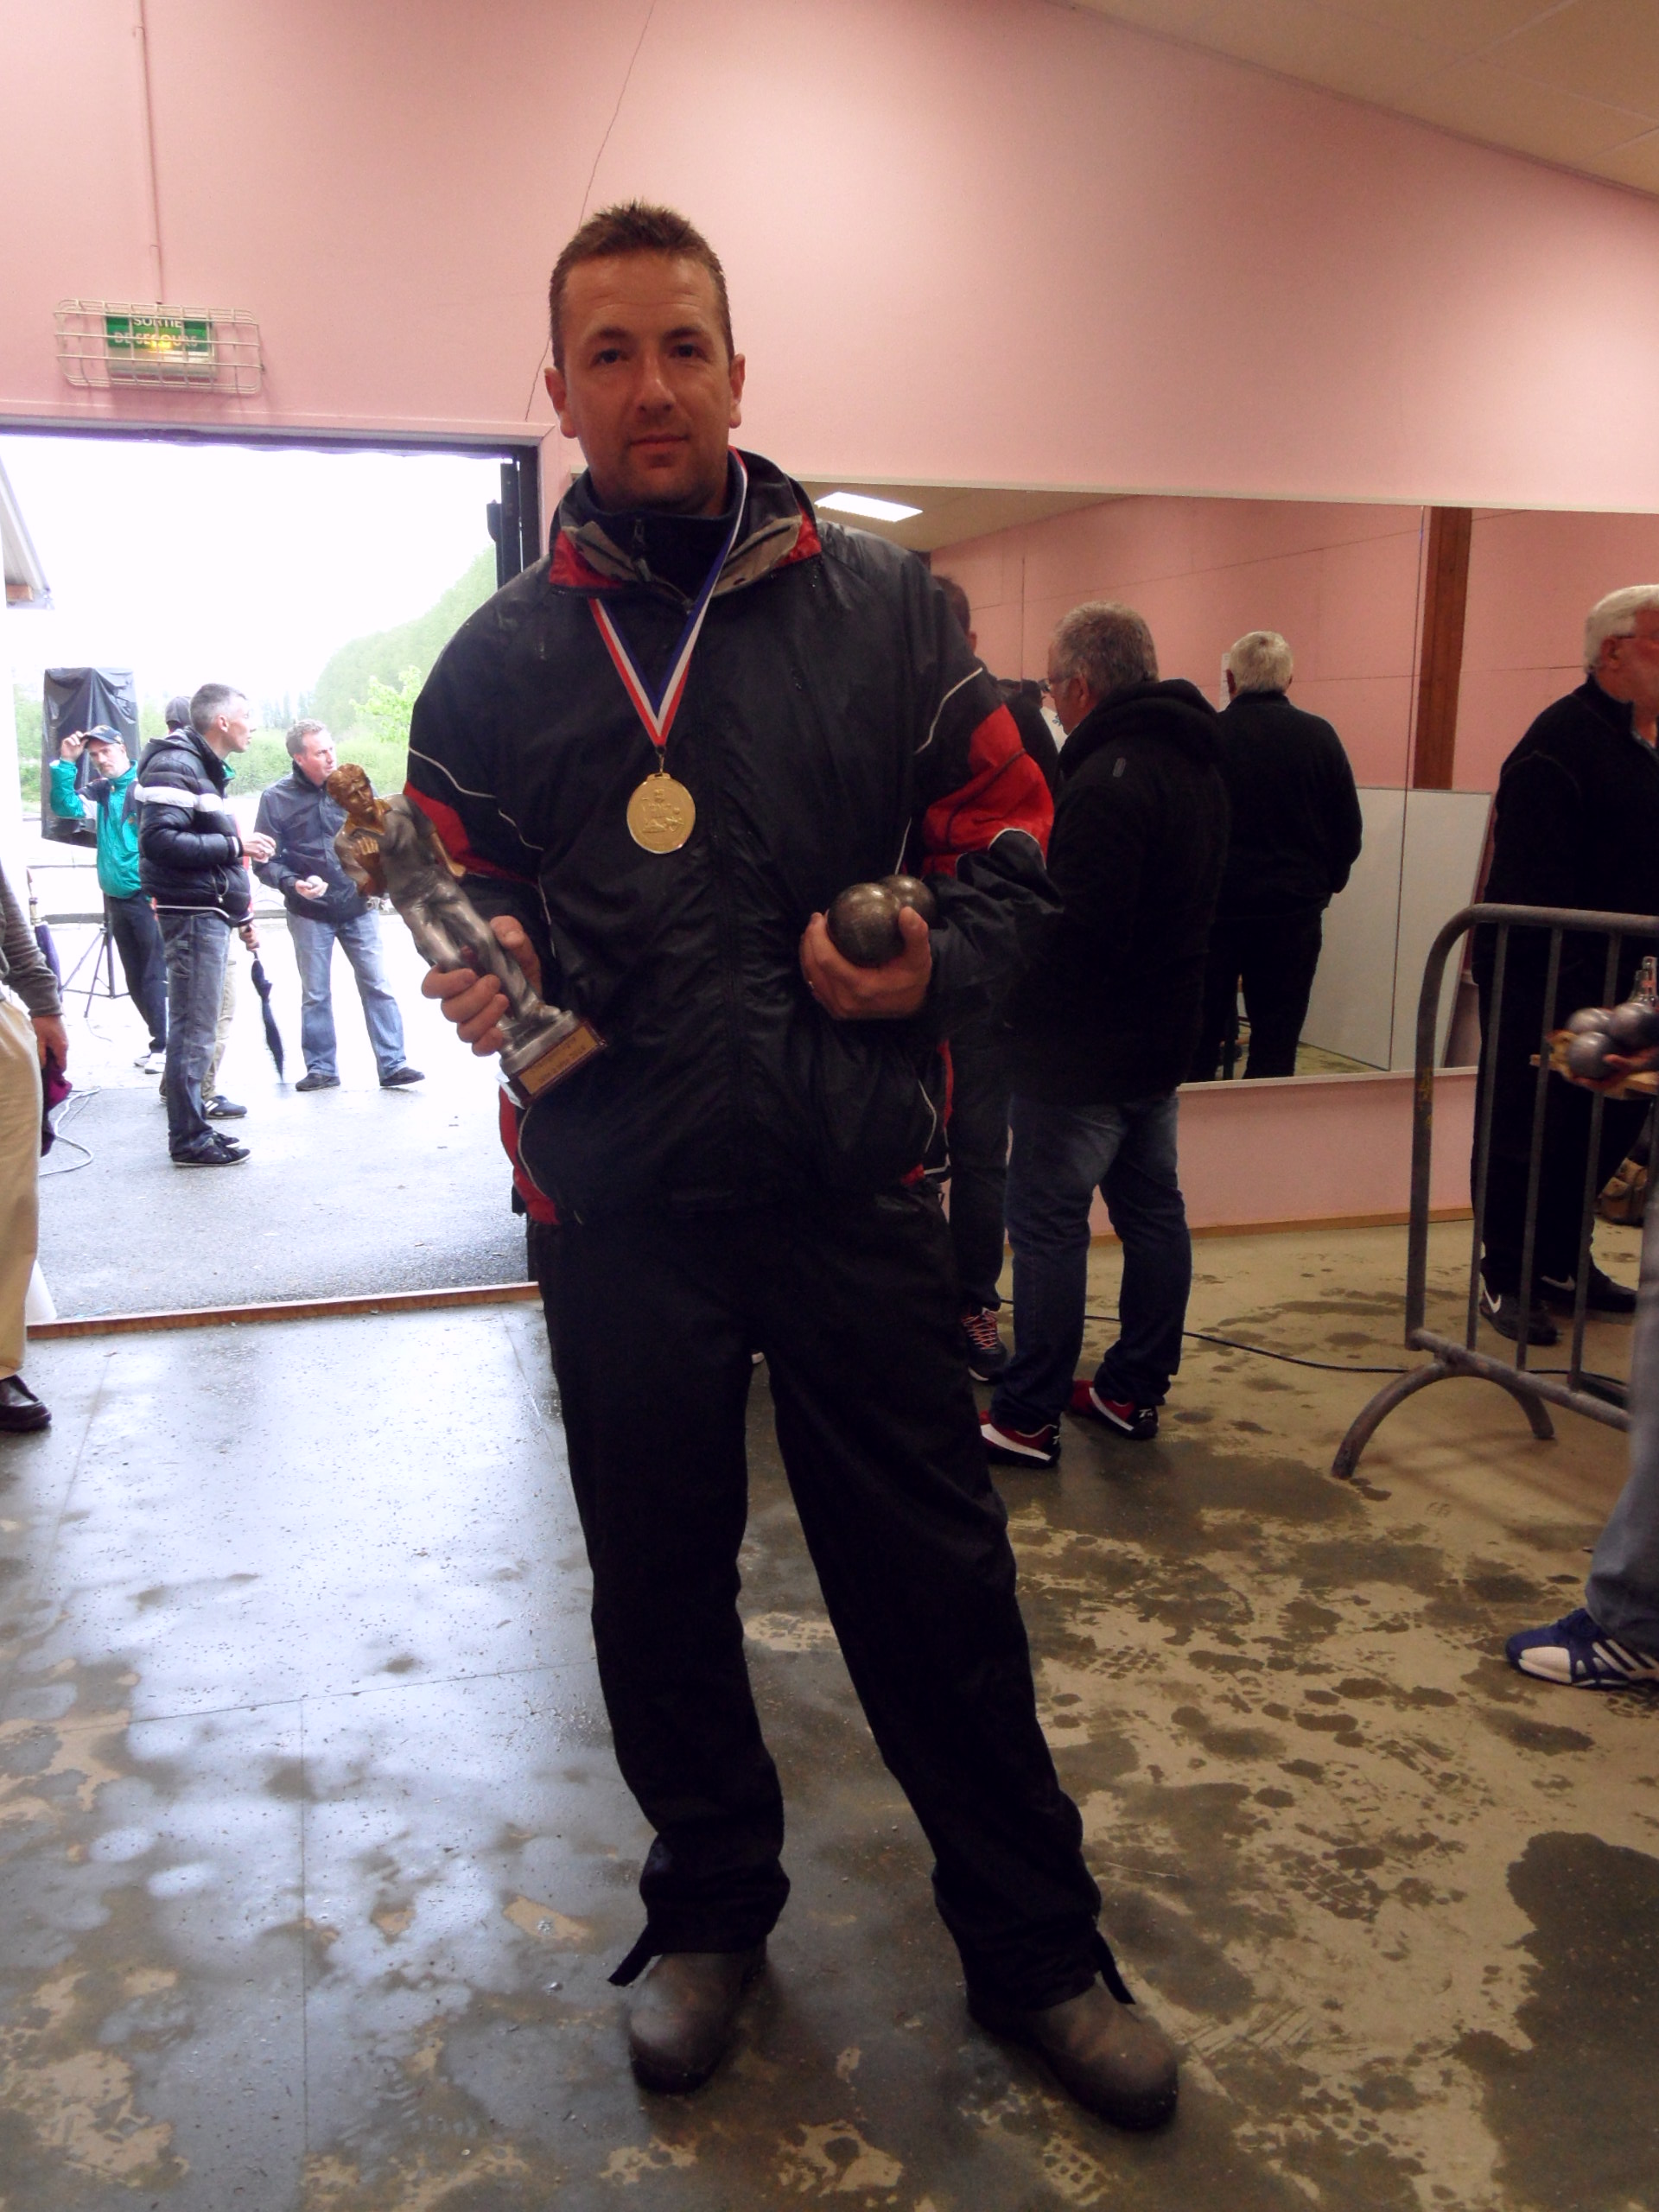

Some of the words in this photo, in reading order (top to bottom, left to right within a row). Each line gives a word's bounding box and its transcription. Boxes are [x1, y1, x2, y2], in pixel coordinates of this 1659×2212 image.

[133, 317, 182, 328] SORTIE
[113, 332, 131, 344] DE
[135, 333, 198, 347] SECOURS
